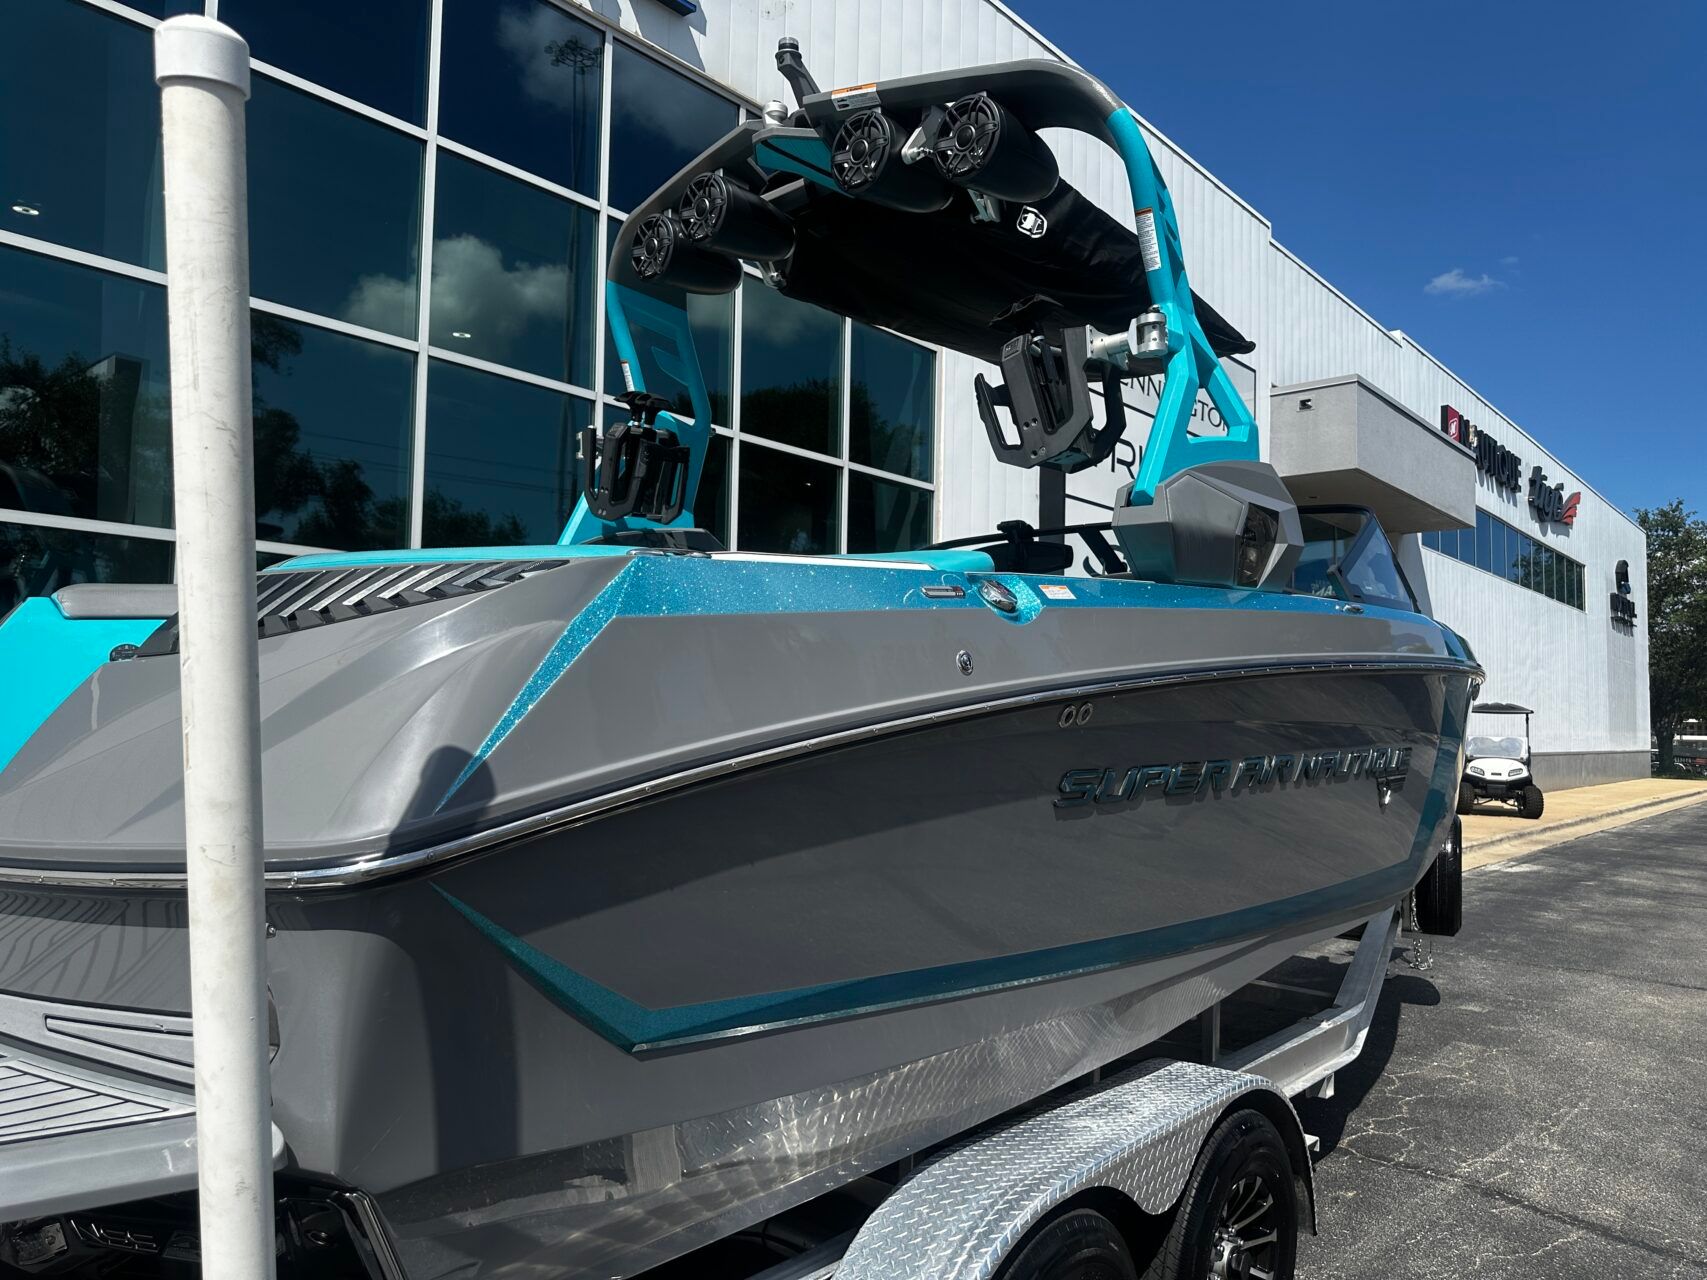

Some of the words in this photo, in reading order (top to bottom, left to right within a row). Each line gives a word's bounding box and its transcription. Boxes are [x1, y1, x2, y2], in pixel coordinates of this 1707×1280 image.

[1053, 758, 1232, 808] SUPER
[1230, 754, 1296, 789] AIR
[1293, 747, 1412, 783] NAUTIQUE
